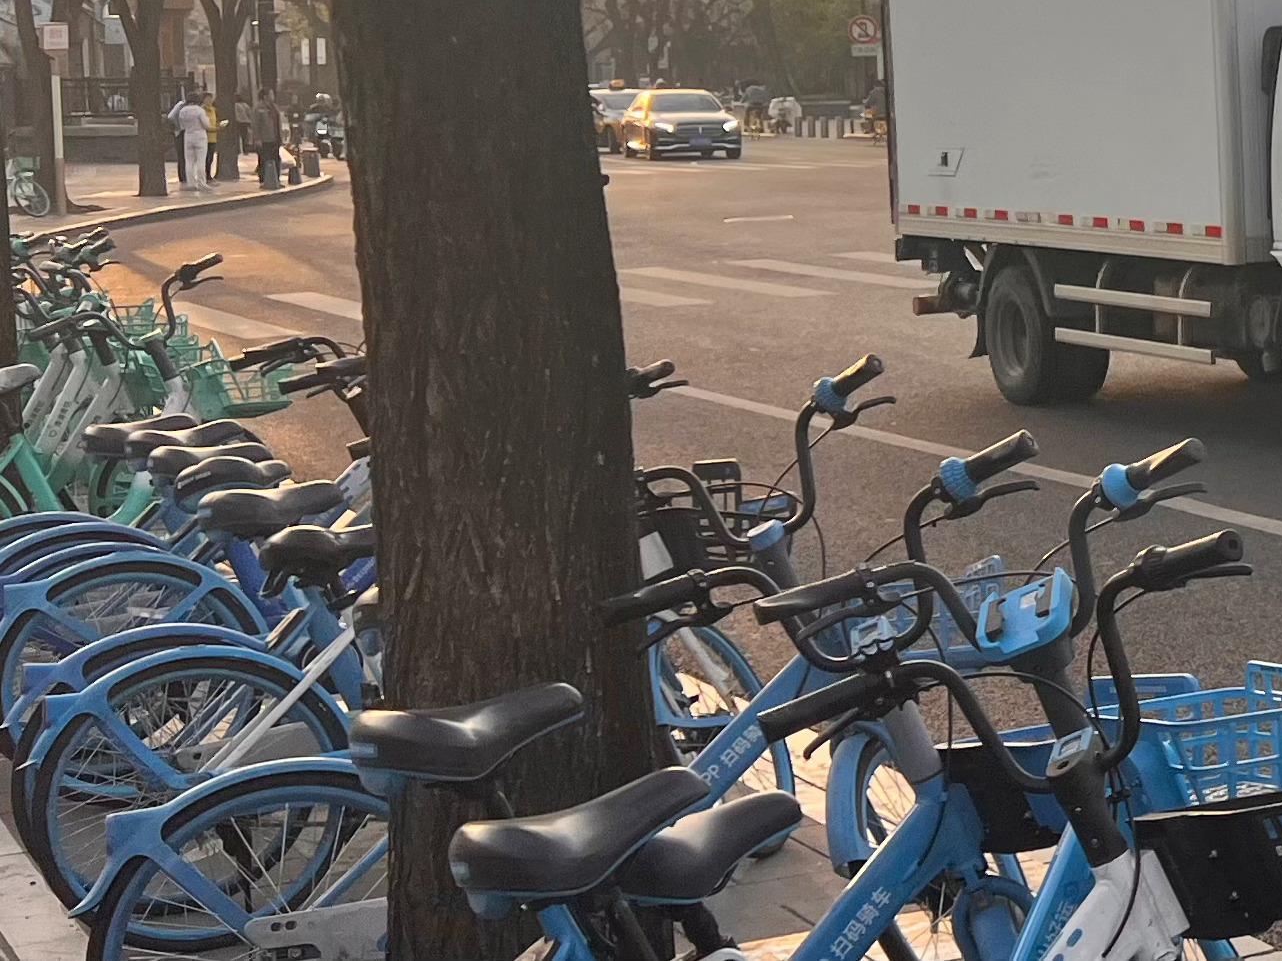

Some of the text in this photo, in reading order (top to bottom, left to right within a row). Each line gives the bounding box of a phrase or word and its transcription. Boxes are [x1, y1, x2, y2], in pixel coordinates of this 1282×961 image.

[720, 724, 763, 768] 扫码骑
[831, 886, 892, 960] 扫码骑车
